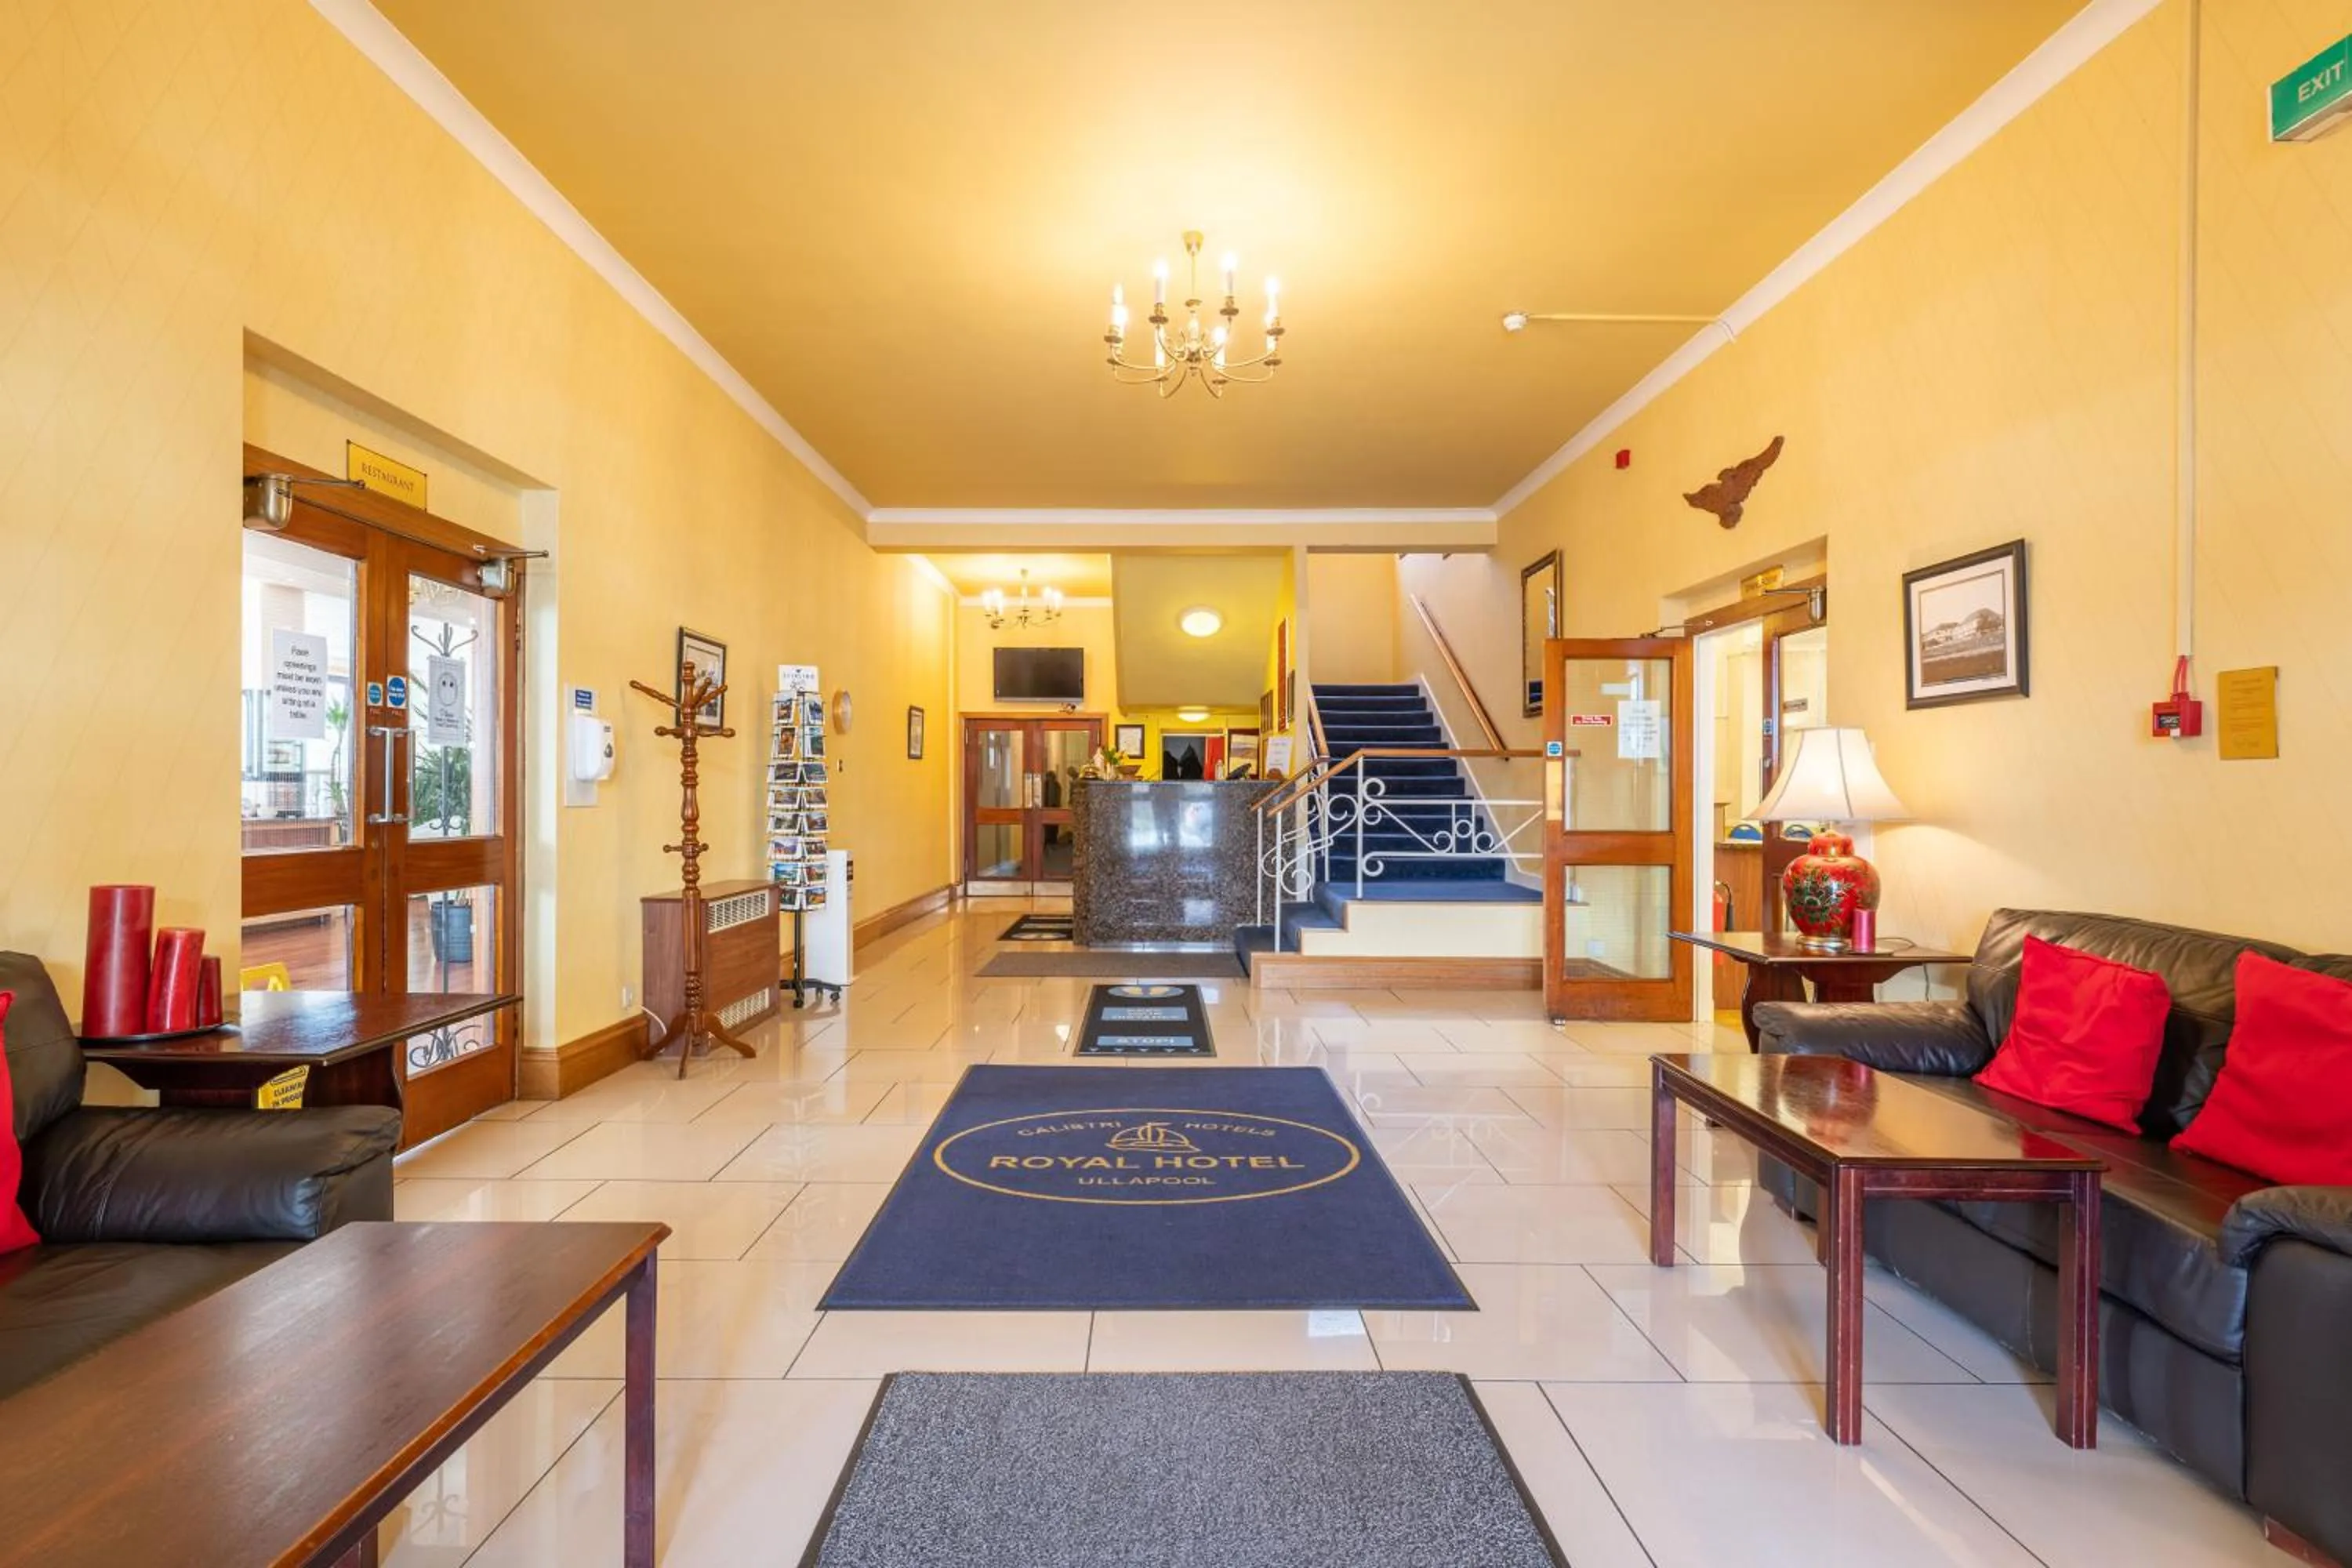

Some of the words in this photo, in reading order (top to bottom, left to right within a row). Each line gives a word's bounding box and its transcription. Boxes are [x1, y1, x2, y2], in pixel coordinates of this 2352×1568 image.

[2298, 59, 2345, 103] EXIT
[361, 462, 414, 492] RESTAURANT
[1017, 1121, 1122, 1137] CALISTRI
[1184, 1122, 1277, 1137] HOTELS
[989, 1156, 1141, 1170] ROYAL
[1154, 1156, 1305, 1169] HOTEL
[1077, 1176, 1217, 1185] ULLAPOOL
